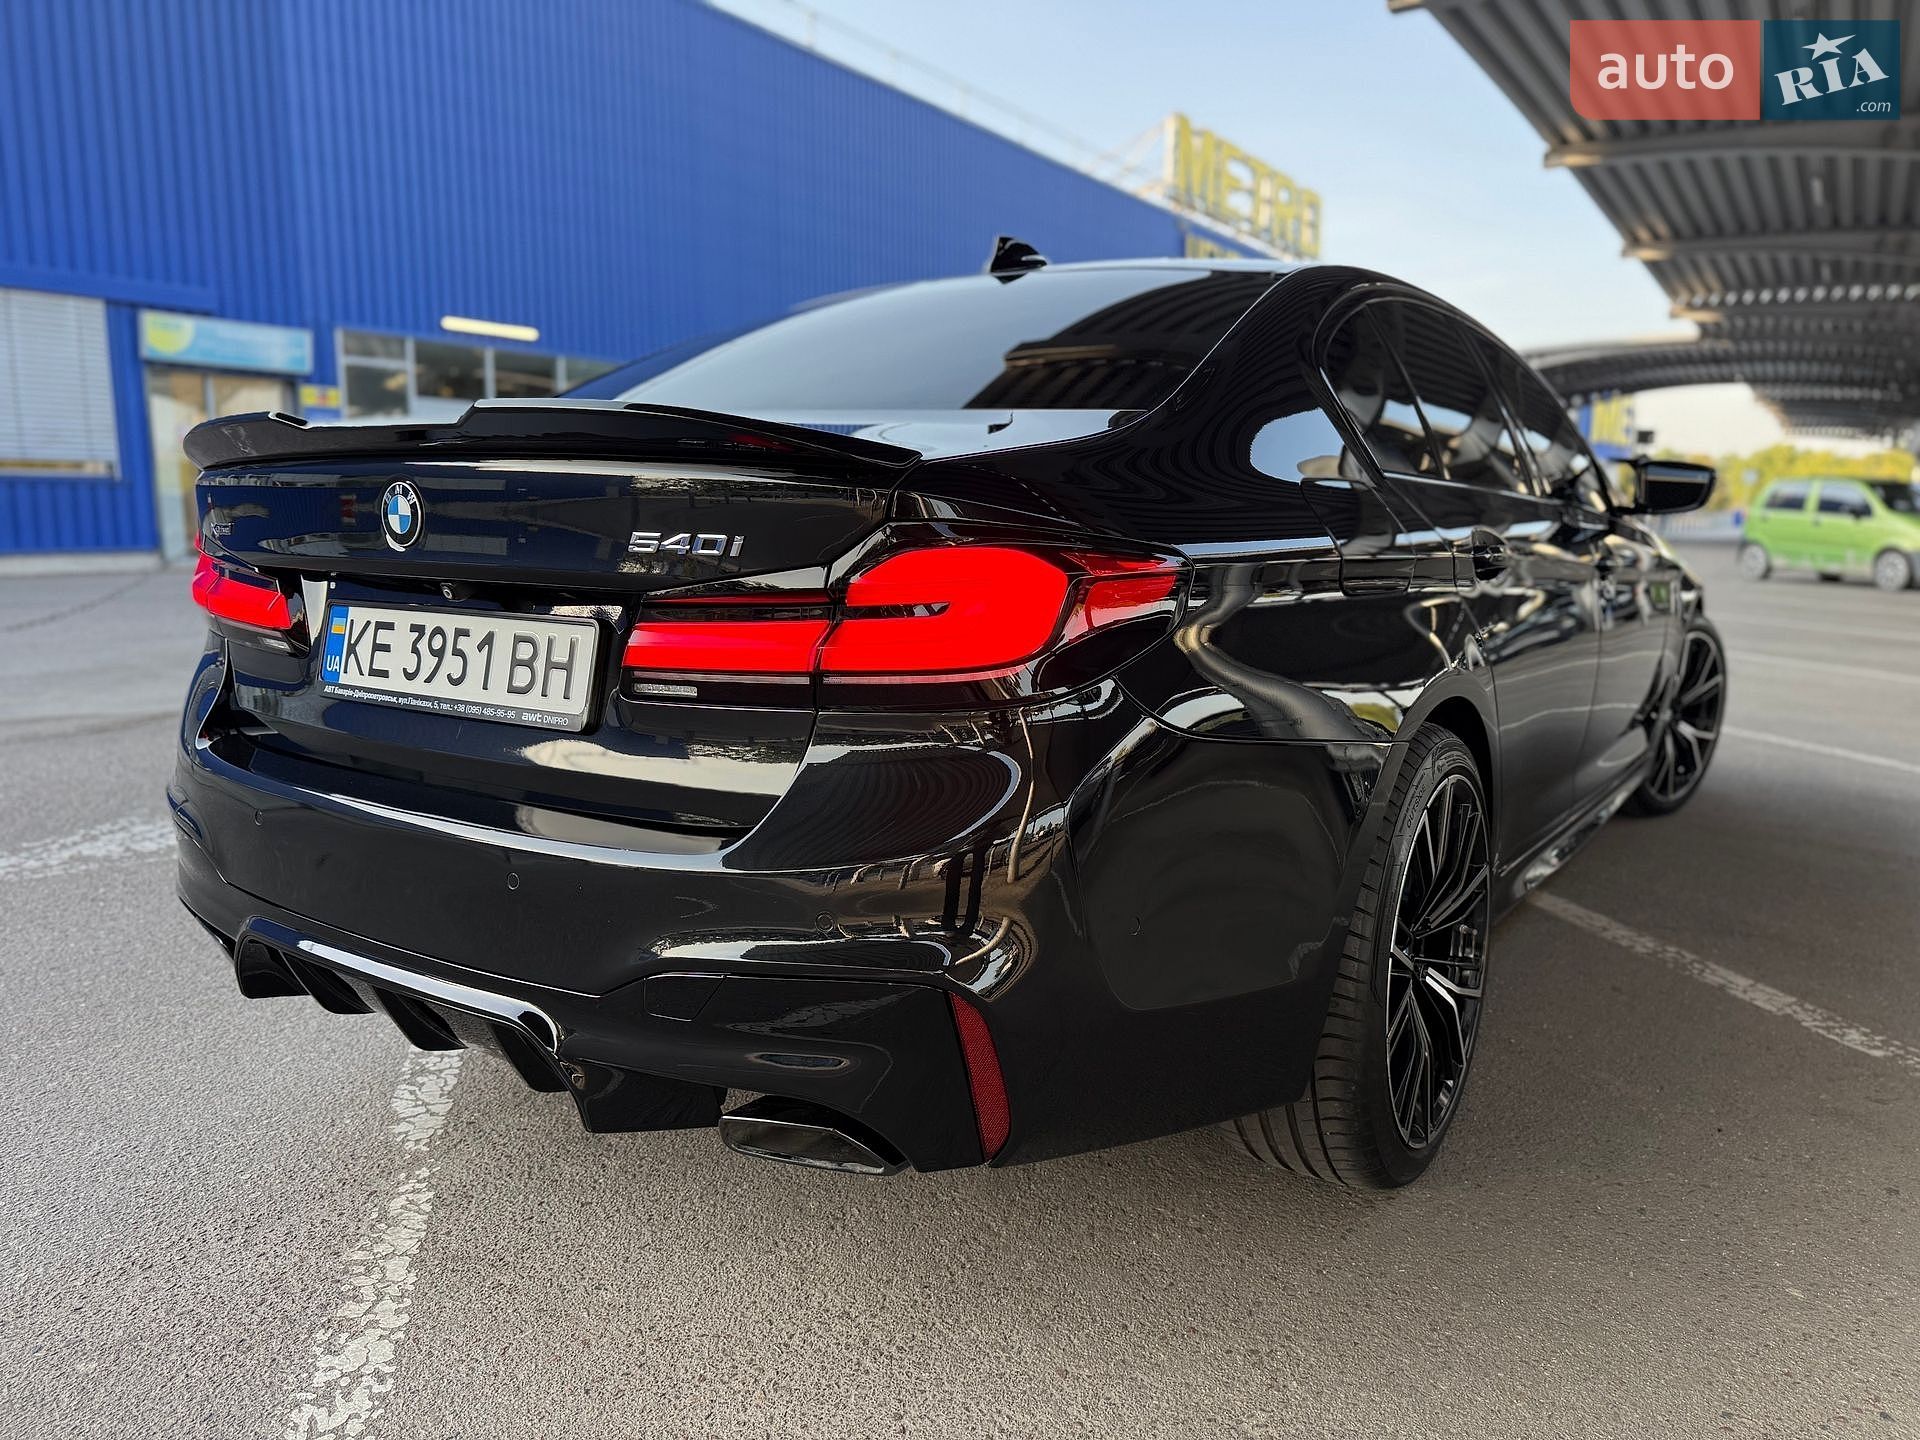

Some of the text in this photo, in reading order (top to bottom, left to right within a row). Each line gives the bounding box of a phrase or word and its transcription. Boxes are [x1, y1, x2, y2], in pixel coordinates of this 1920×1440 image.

[1163, 112, 1322, 262] METRO
[384, 485, 417, 504] BMW
[628, 531, 745, 557] 540i
[326, 654, 340, 673] UA
[343, 618, 580, 700] KE 3951 BH
[466, 705, 482, 715] (095)
[522, 711, 569, 726] awt DNIPRO
